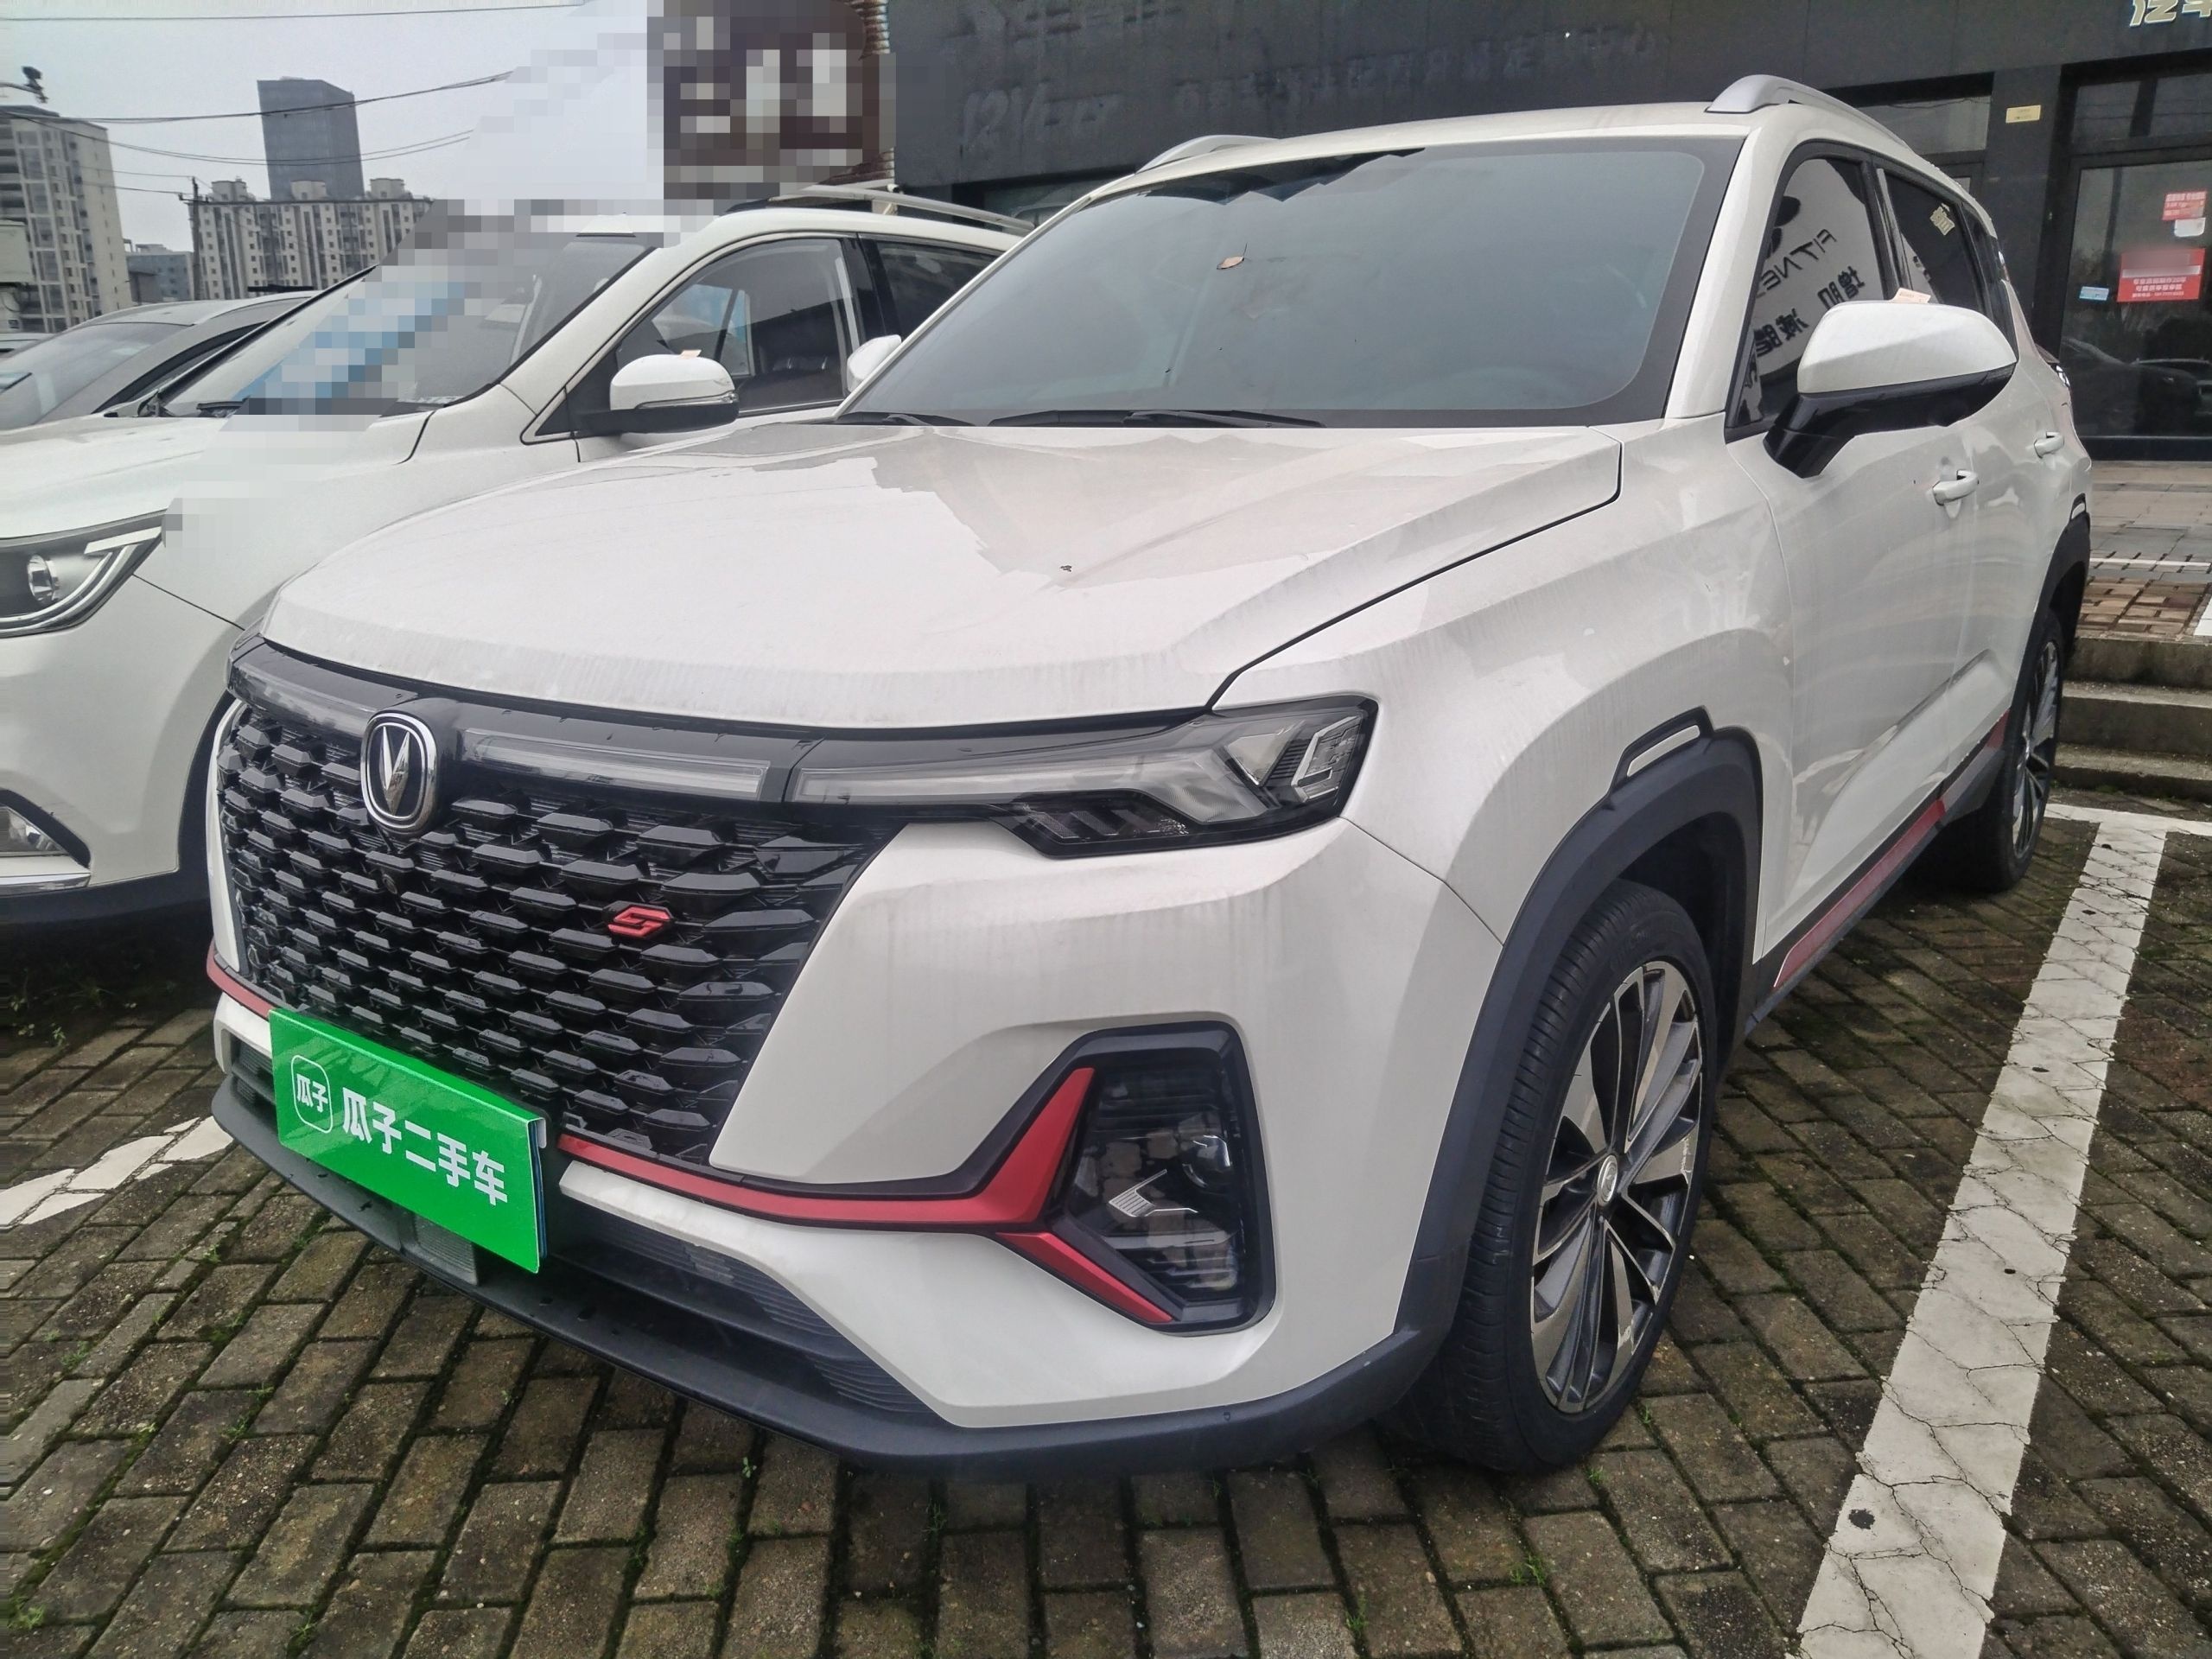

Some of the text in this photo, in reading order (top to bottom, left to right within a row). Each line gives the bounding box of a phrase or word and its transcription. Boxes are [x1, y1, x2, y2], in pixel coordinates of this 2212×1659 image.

[296, 1073, 328, 1112] 瓜子
[342, 1087, 508, 1206] 瓜子二手车
